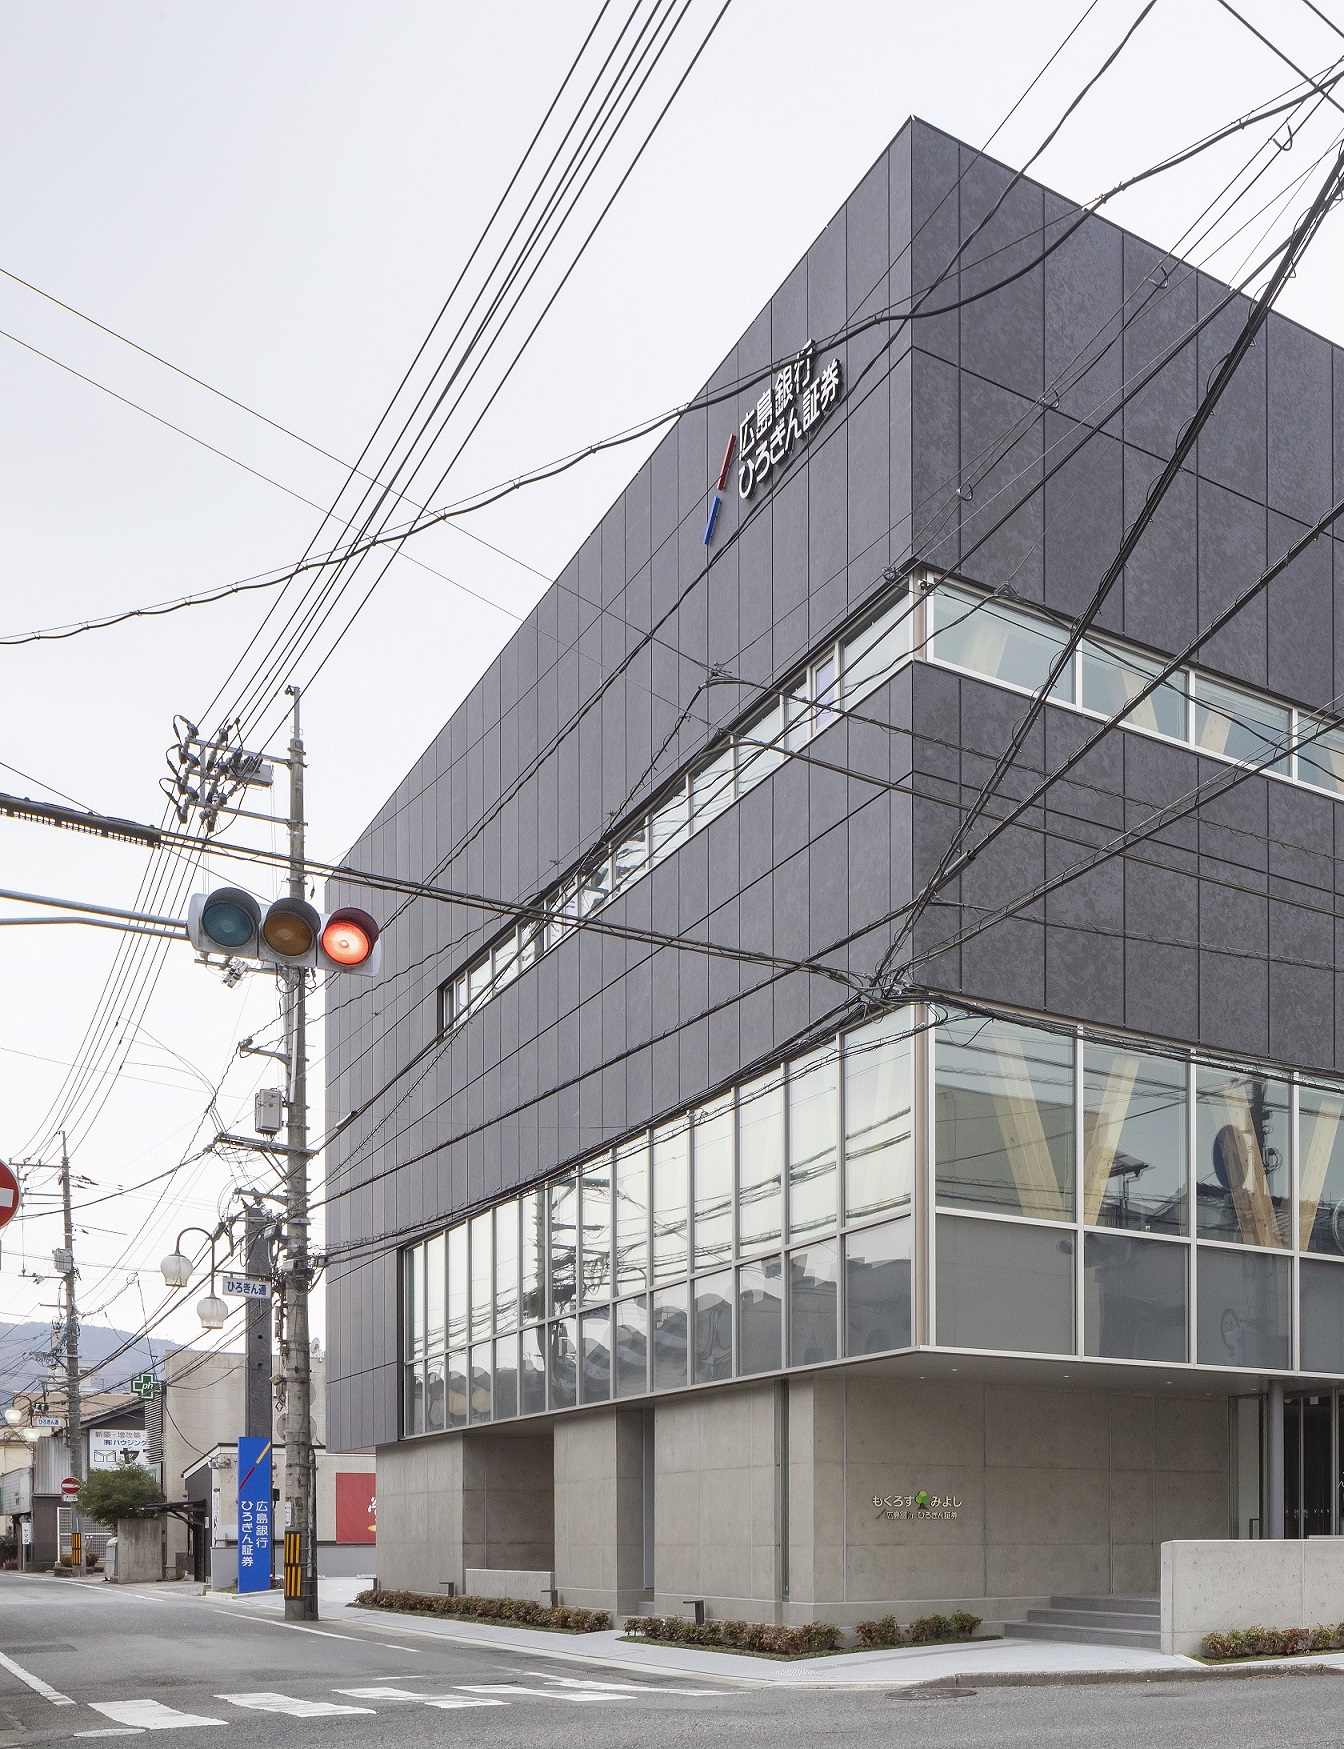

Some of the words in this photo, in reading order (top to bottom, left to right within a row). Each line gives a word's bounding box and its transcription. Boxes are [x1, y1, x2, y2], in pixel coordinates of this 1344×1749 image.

[738, 358, 840, 499] ひろぎん証券
[227, 1281, 267, 1296] ひろぎん通
[142, 1381, 154, 1390] ph
[930, 1496, 963, 1508] みよし
[241, 1501, 254, 1567] ひろぎん証券
[255, 1501, 268, 1548] 広島銀行
